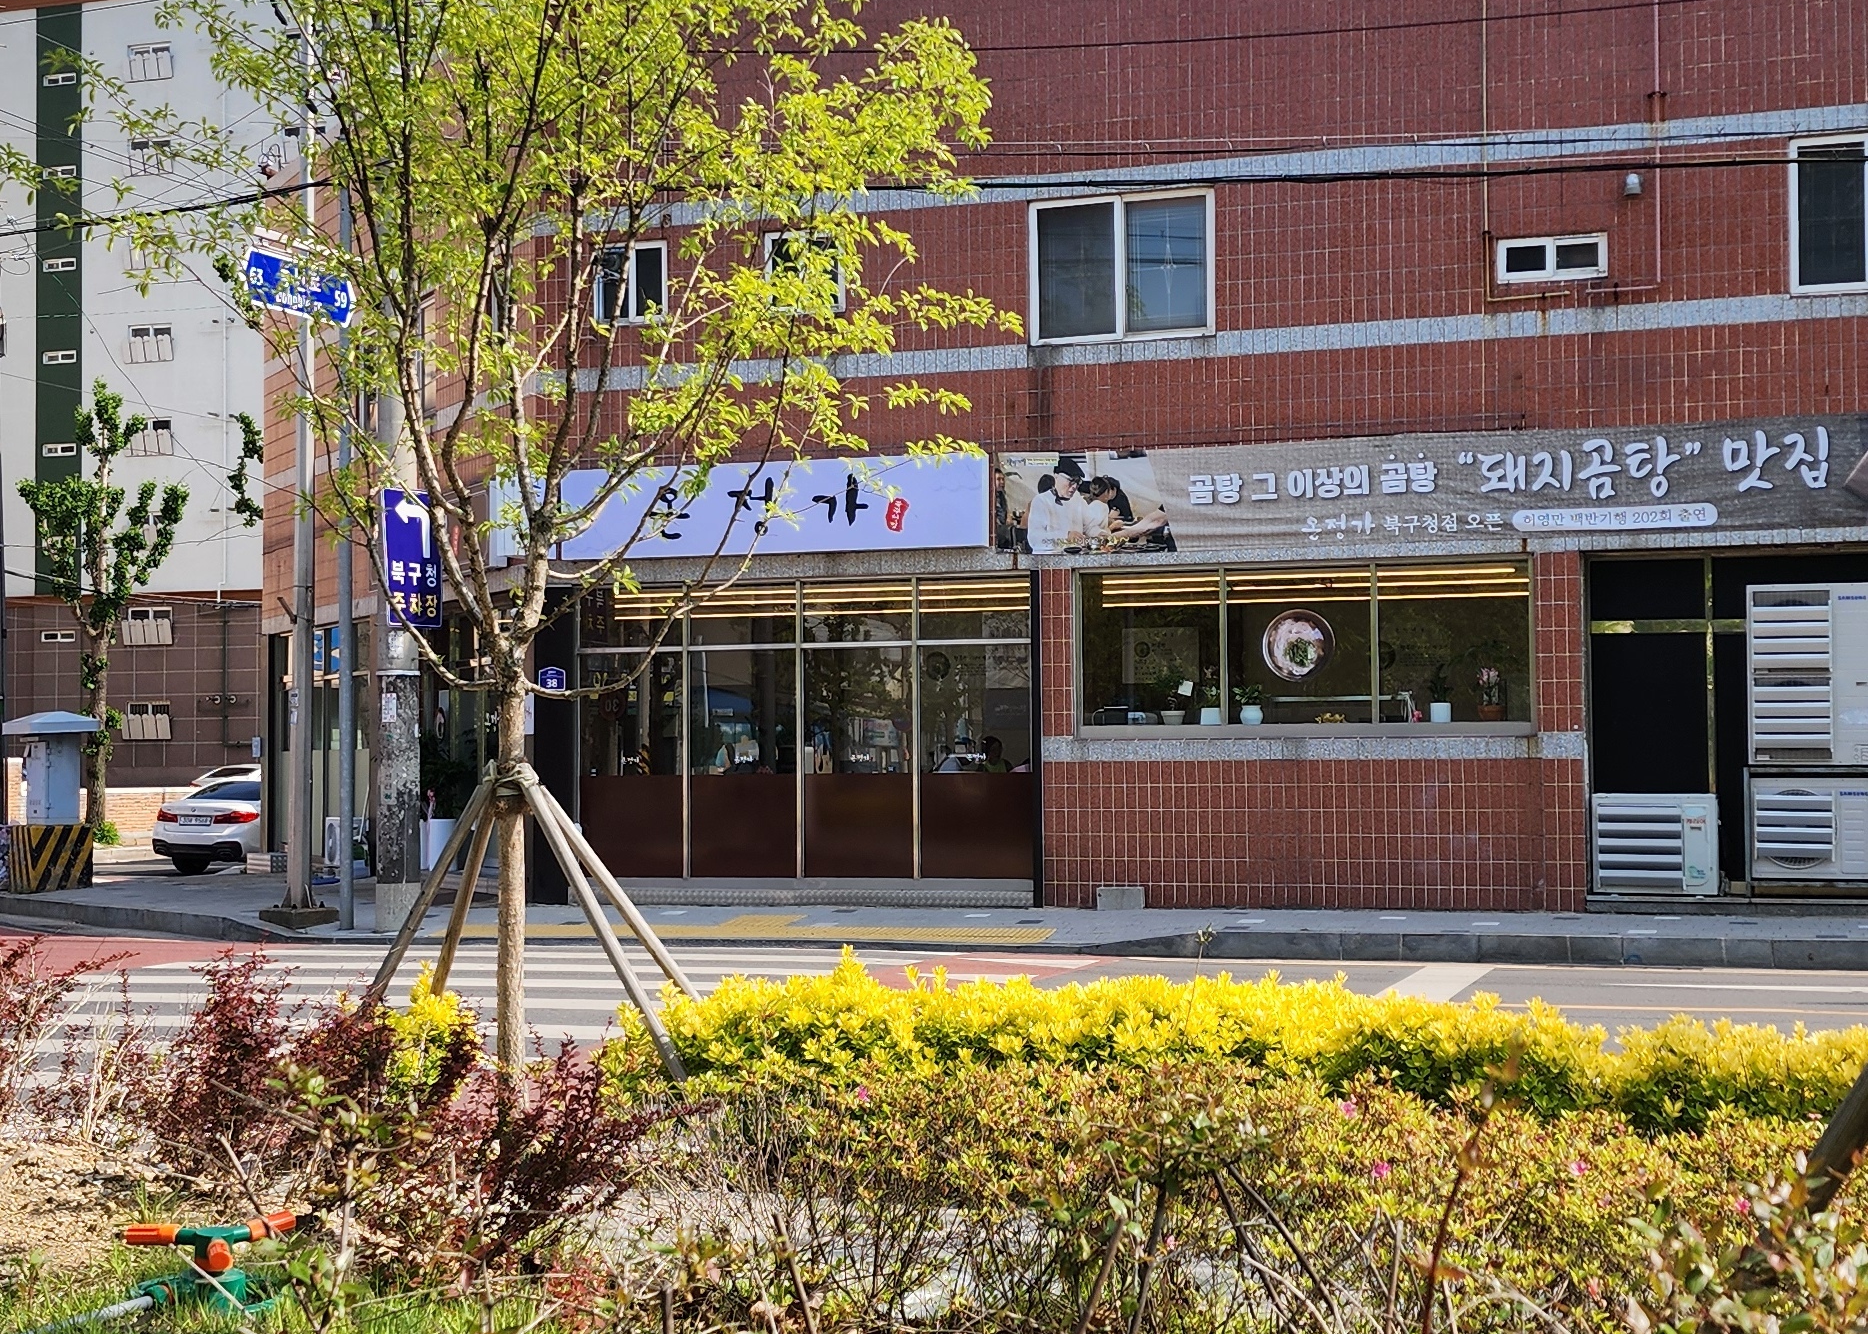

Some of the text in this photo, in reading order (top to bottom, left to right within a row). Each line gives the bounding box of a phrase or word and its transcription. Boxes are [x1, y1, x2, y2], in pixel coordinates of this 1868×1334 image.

[334, 290, 348, 308] 59
[1188, 473, 1243, 505] 곰탕
[1251, 472, 1278, 501] 그
[1287, 465, 1370, 499] 이상의
[1380, 454, 1438, 494] 곰탕
[1722, 426, 1830, 492] 맛집
[1301, 511, 1504, 541] 온정가 북구청점 오픈
[1523, 507, 1707, 527] 허영만 백반기행 202회 출연
[391, 560, 437, 588] 북구청
[391, 592, 437, 618] 주차장
[545, 678, 558, 688] 38
